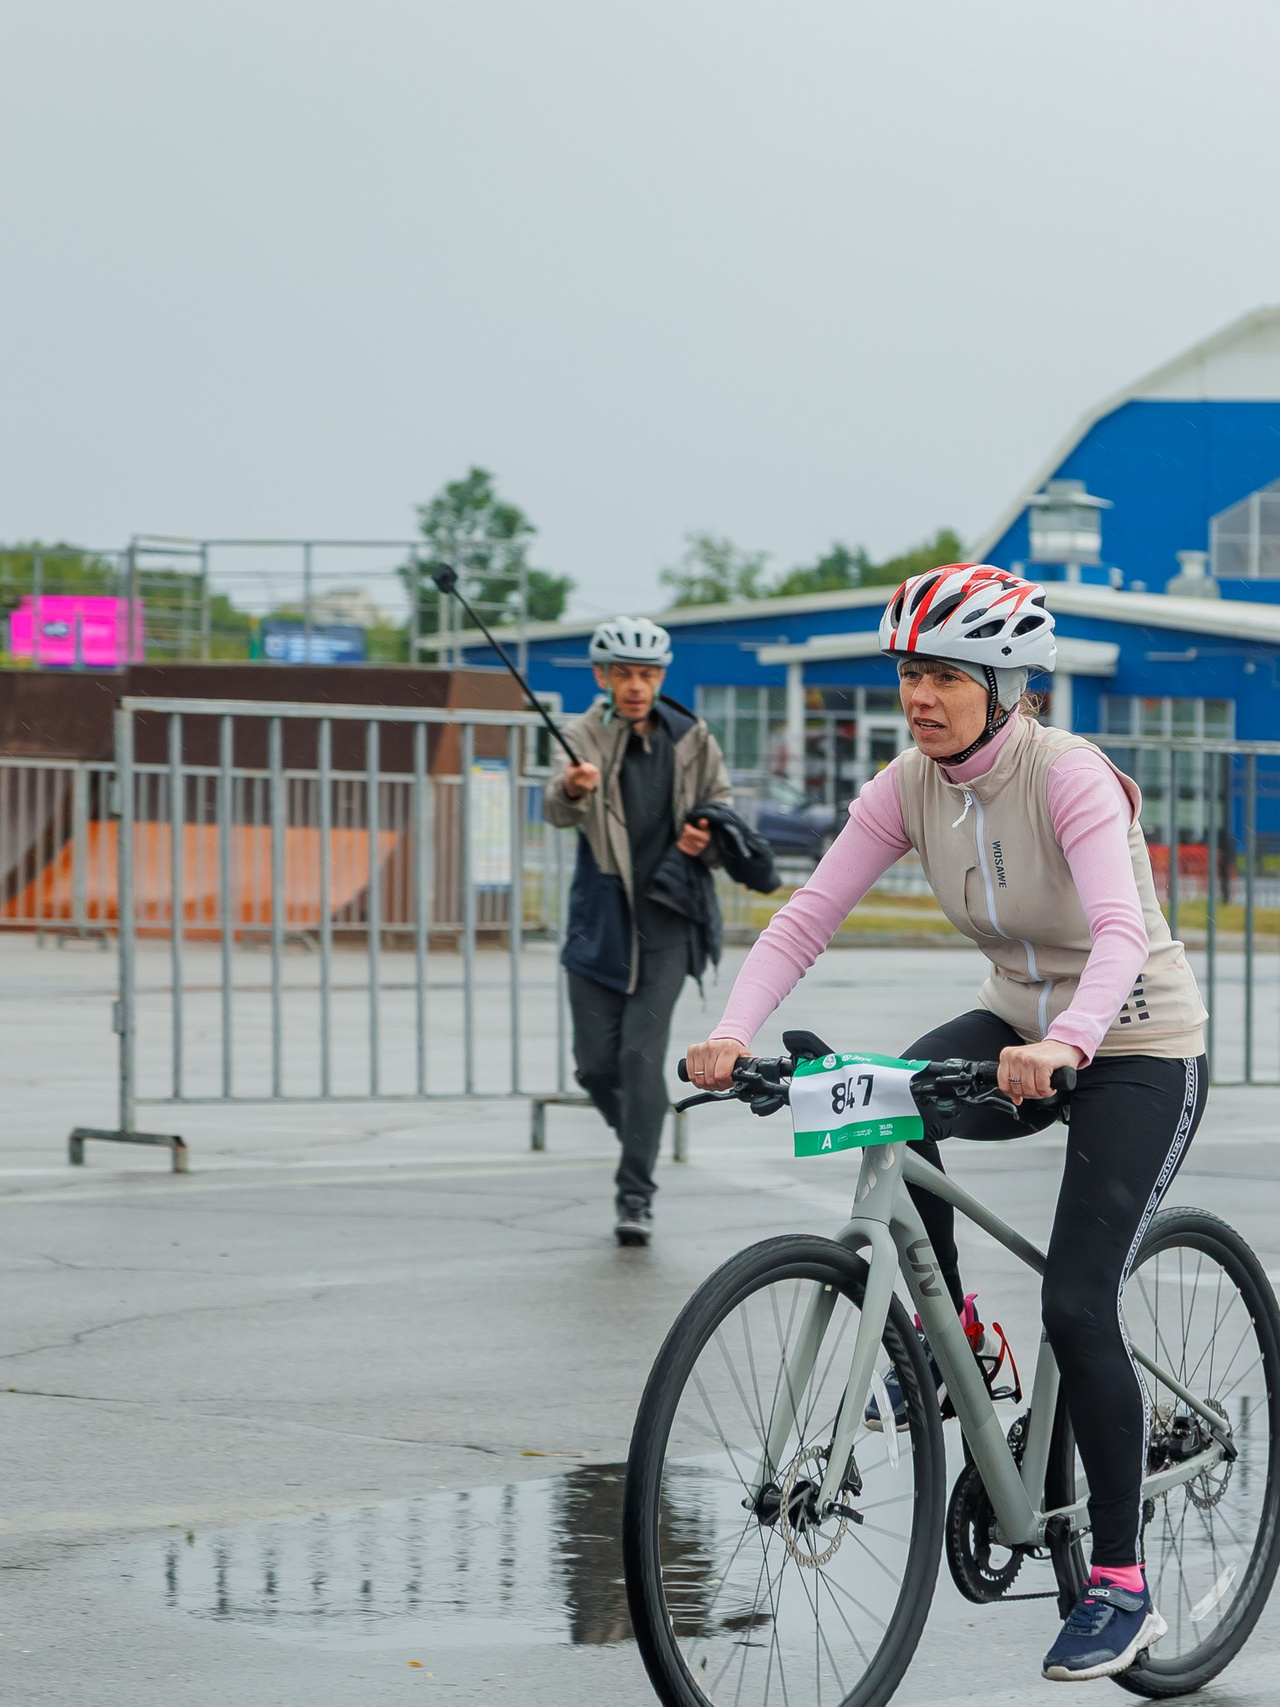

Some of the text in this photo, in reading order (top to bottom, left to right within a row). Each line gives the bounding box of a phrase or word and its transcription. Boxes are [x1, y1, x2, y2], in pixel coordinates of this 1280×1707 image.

[991, 840, 1007, 889] WOSAWE
[831, 1071, 874, 1115] 847
[821, 1132, 832, 1150] A
[1158, 1133, 1186, 1187] Kappa
